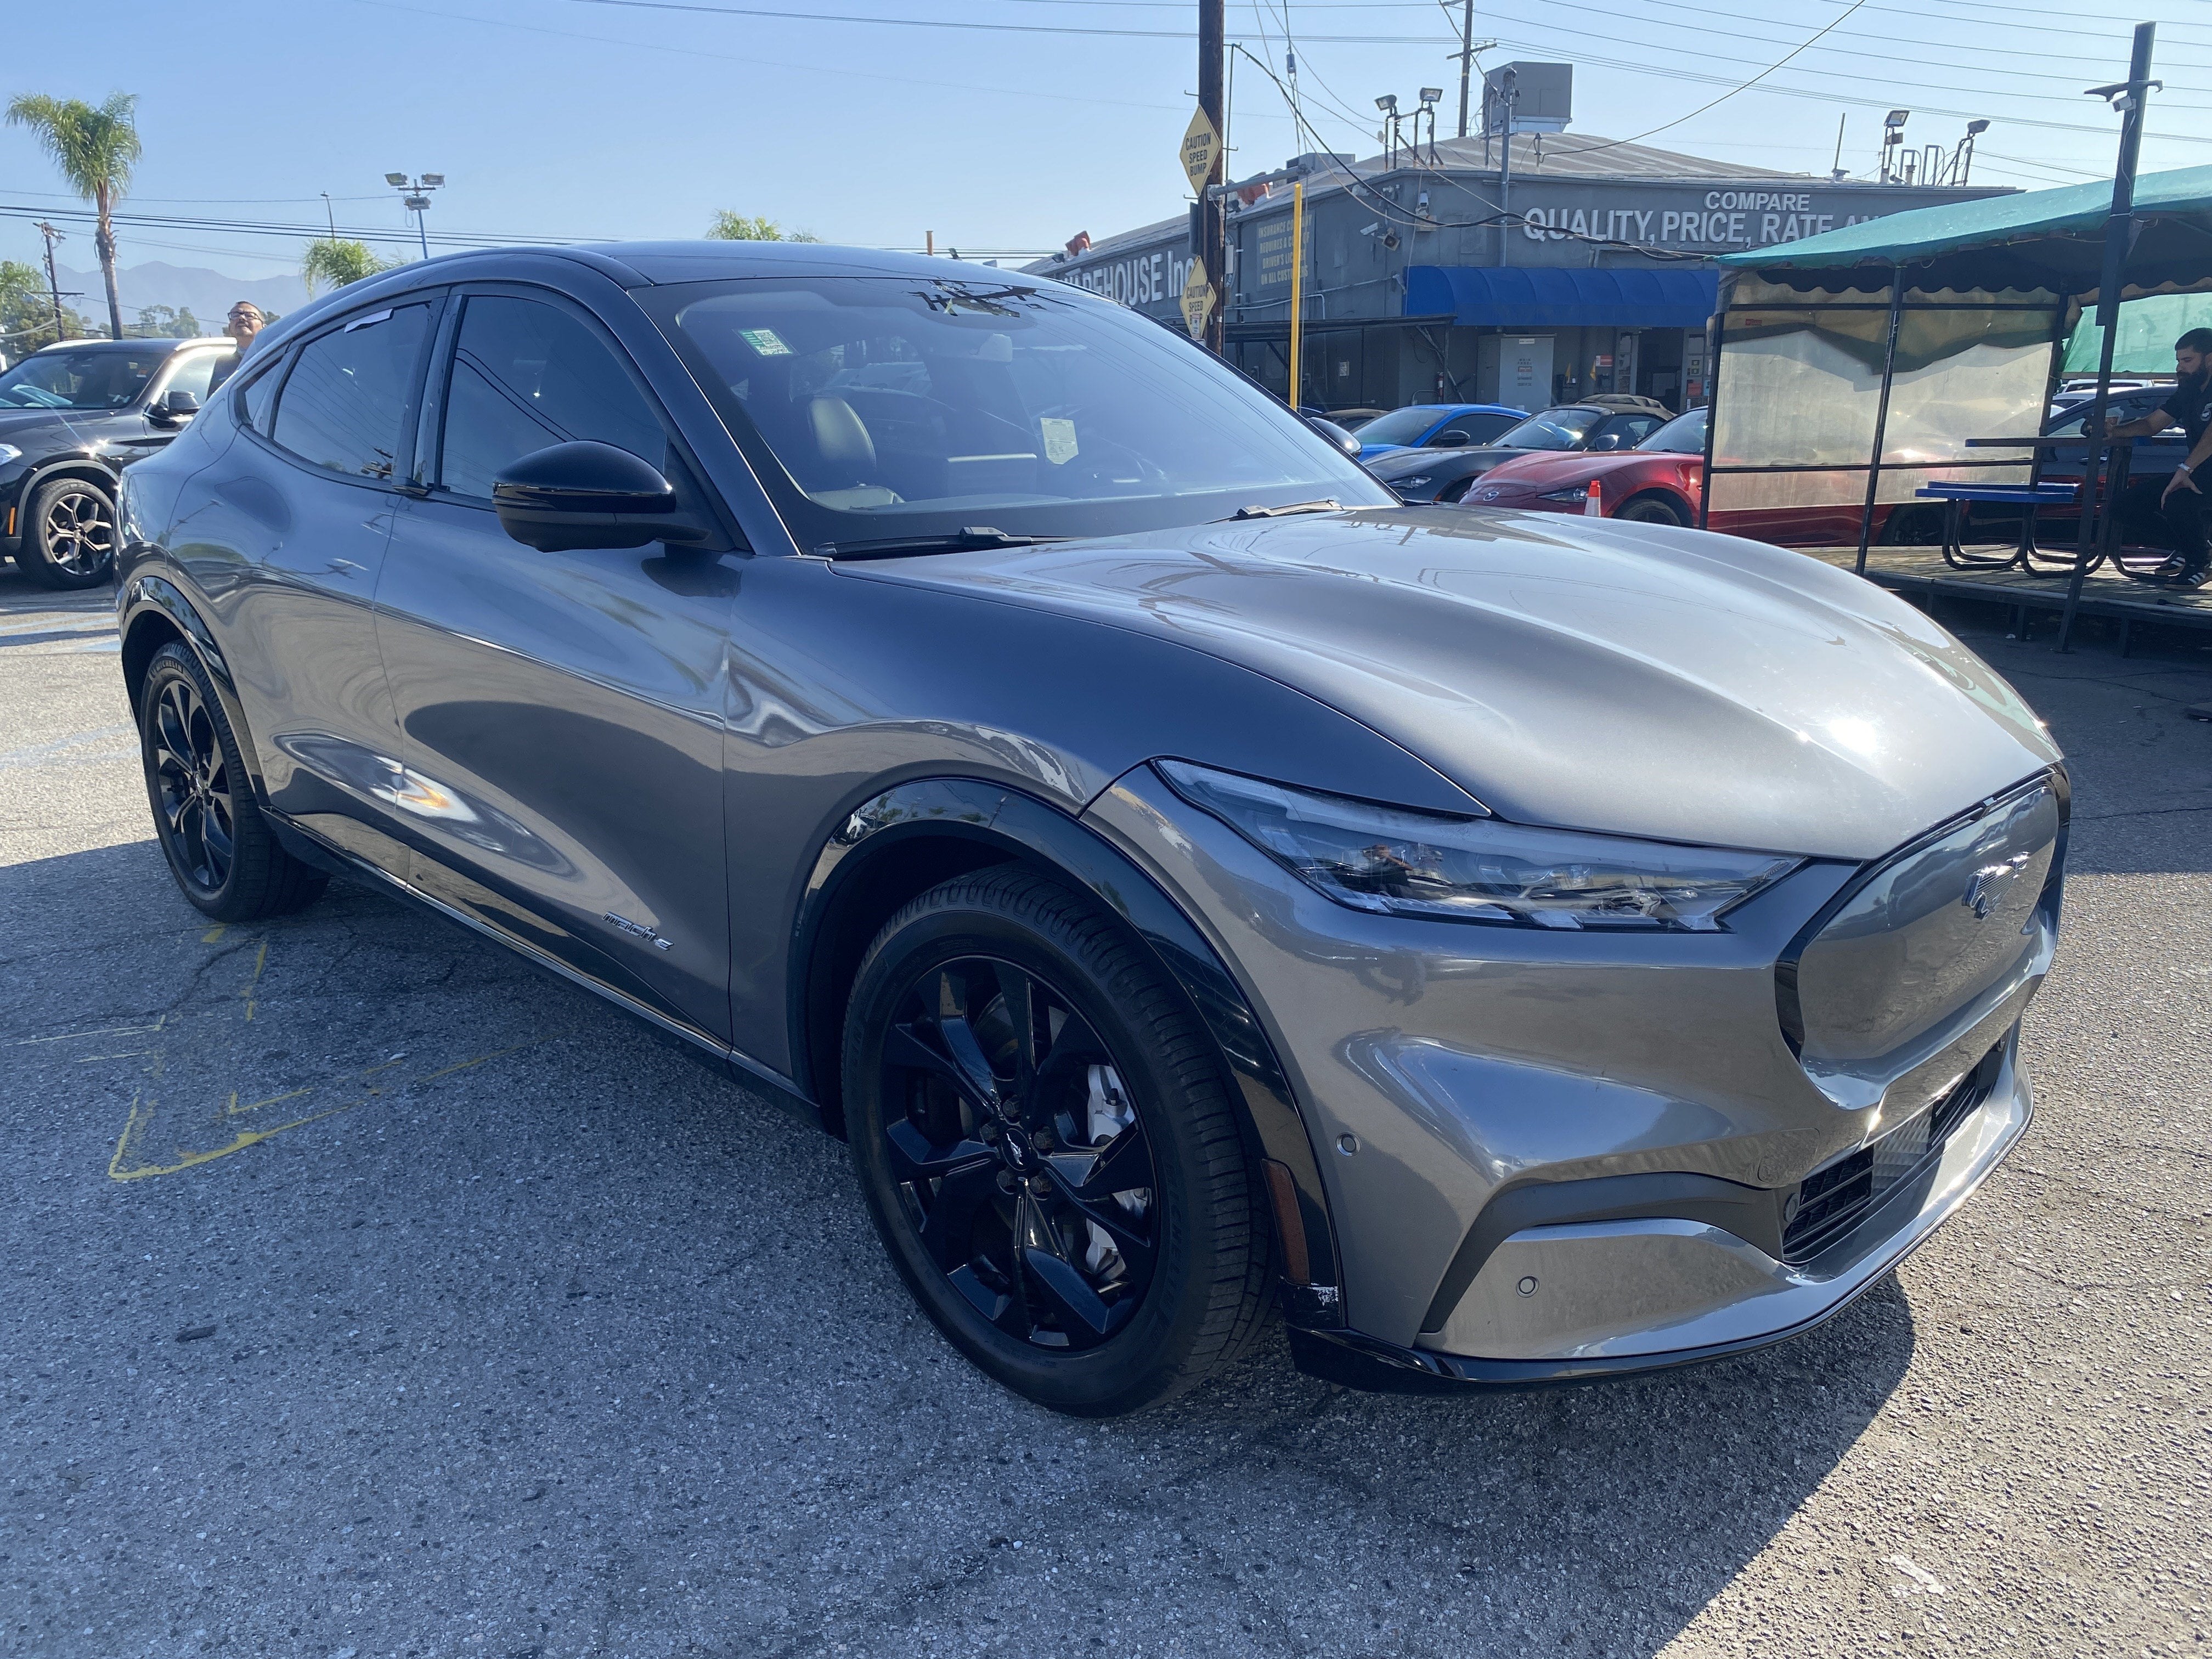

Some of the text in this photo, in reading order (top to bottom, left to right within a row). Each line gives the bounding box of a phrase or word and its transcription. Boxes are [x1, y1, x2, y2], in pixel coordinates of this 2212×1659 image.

[1186, 132, 1211, 151] CAUTION
[1189, 150, 1207, 164] SPEED
[1190, 162, 1207, 177] BUMP
[1704, 191, 1810, 212] COMPARE
[1523, 207, 1833, 249] QUALITY, PRICE, RATE
[1187, 284, 1207, 299] CAUTION
[1189, 301, 1203, 312] SPEED
